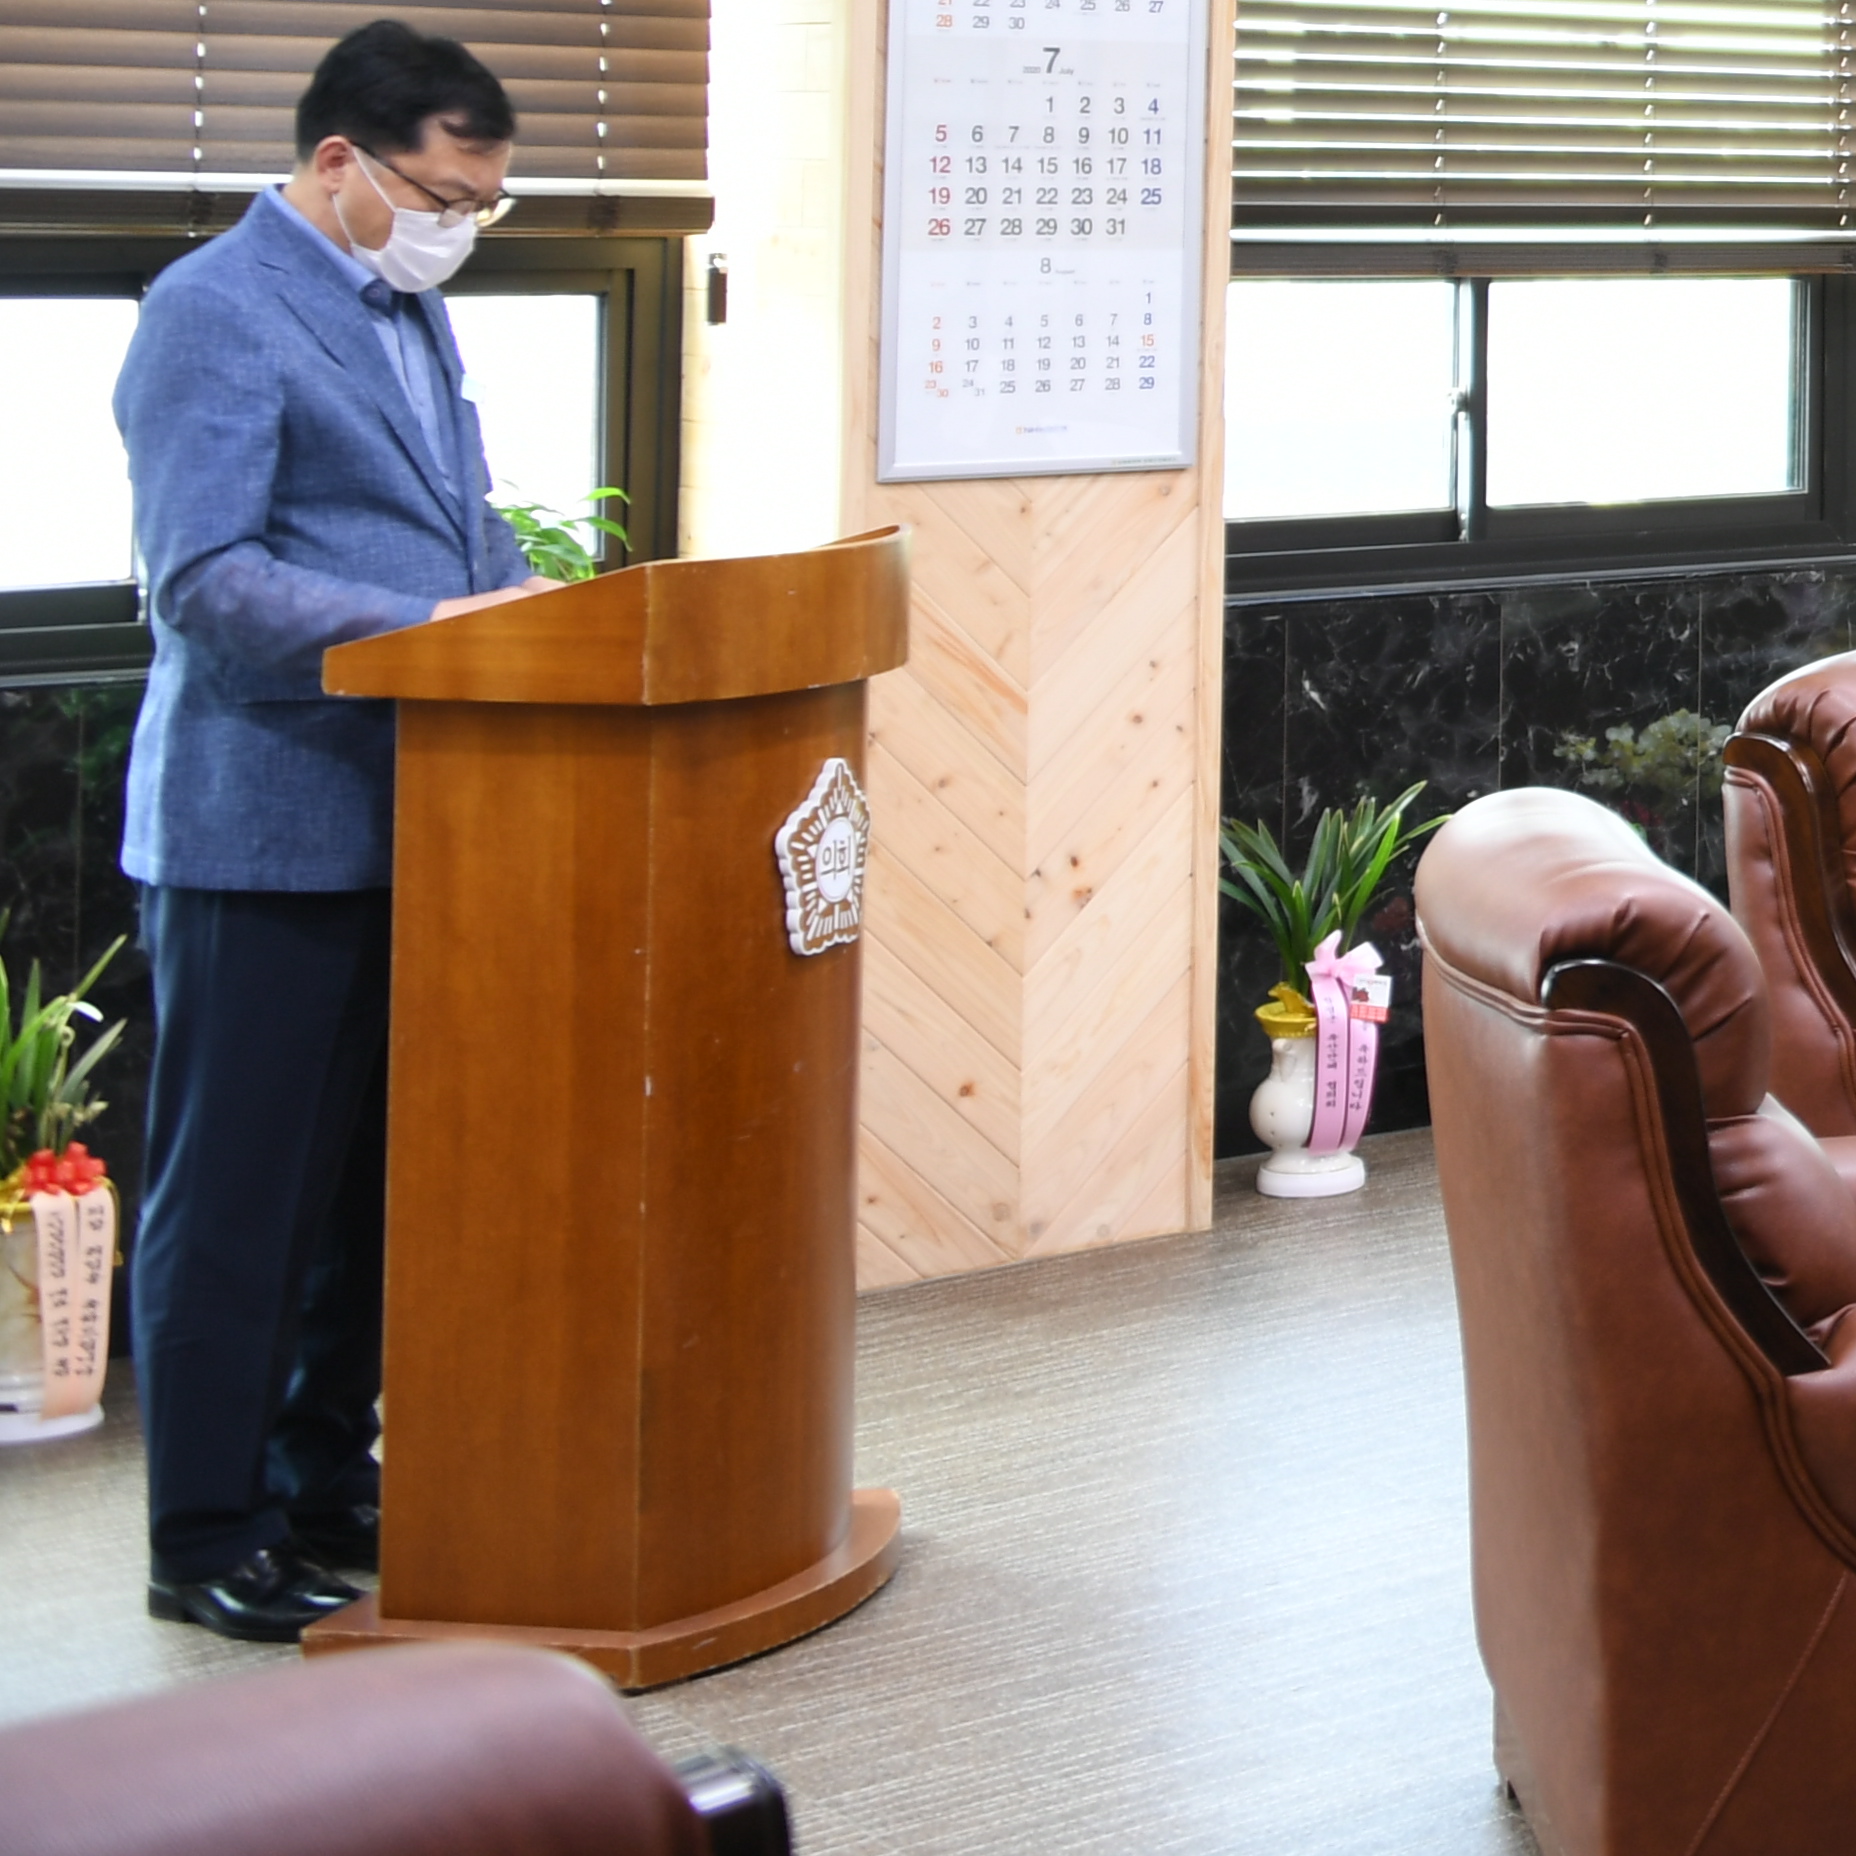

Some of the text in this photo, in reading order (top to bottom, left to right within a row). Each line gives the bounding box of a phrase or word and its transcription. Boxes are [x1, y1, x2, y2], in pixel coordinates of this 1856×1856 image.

[1148, 0, 1164, 14] 27
[935, 14, 1026, 30] 28 29 30
[1042, 47, 1061, 74] 7
[1046, 96, 1160, 115] 1 2 3 4
[935, 124, 1162, 145] 5 6 7 8 9 10 11
[929, 155, 1162, 176] 12 13 14 15 16 17 18
[928, 186, 1162, 206] 19 20 21 22 23 24 25
[927, 217, 1126, 236] 26 27 28 29 30 31
[1039, 256, 1052, 275] 8
[932, 312, 1153, 330] 2 3 4 5 6 7 8
[931, 333, 1155, 352] 9 10 11 12 13 14 15
[928, 355, 1156, 374] 16 17 18 19 20 21 22
[999, 379, 1017, 394] 25
[1034, 379, 1052, 393] 26
[1069, 377, 1086, 392] 27
[1104, 377, 1121, 391] 28
[1138, 376, 1155, 390] 29
[820, 834, 851, 881] 의회
